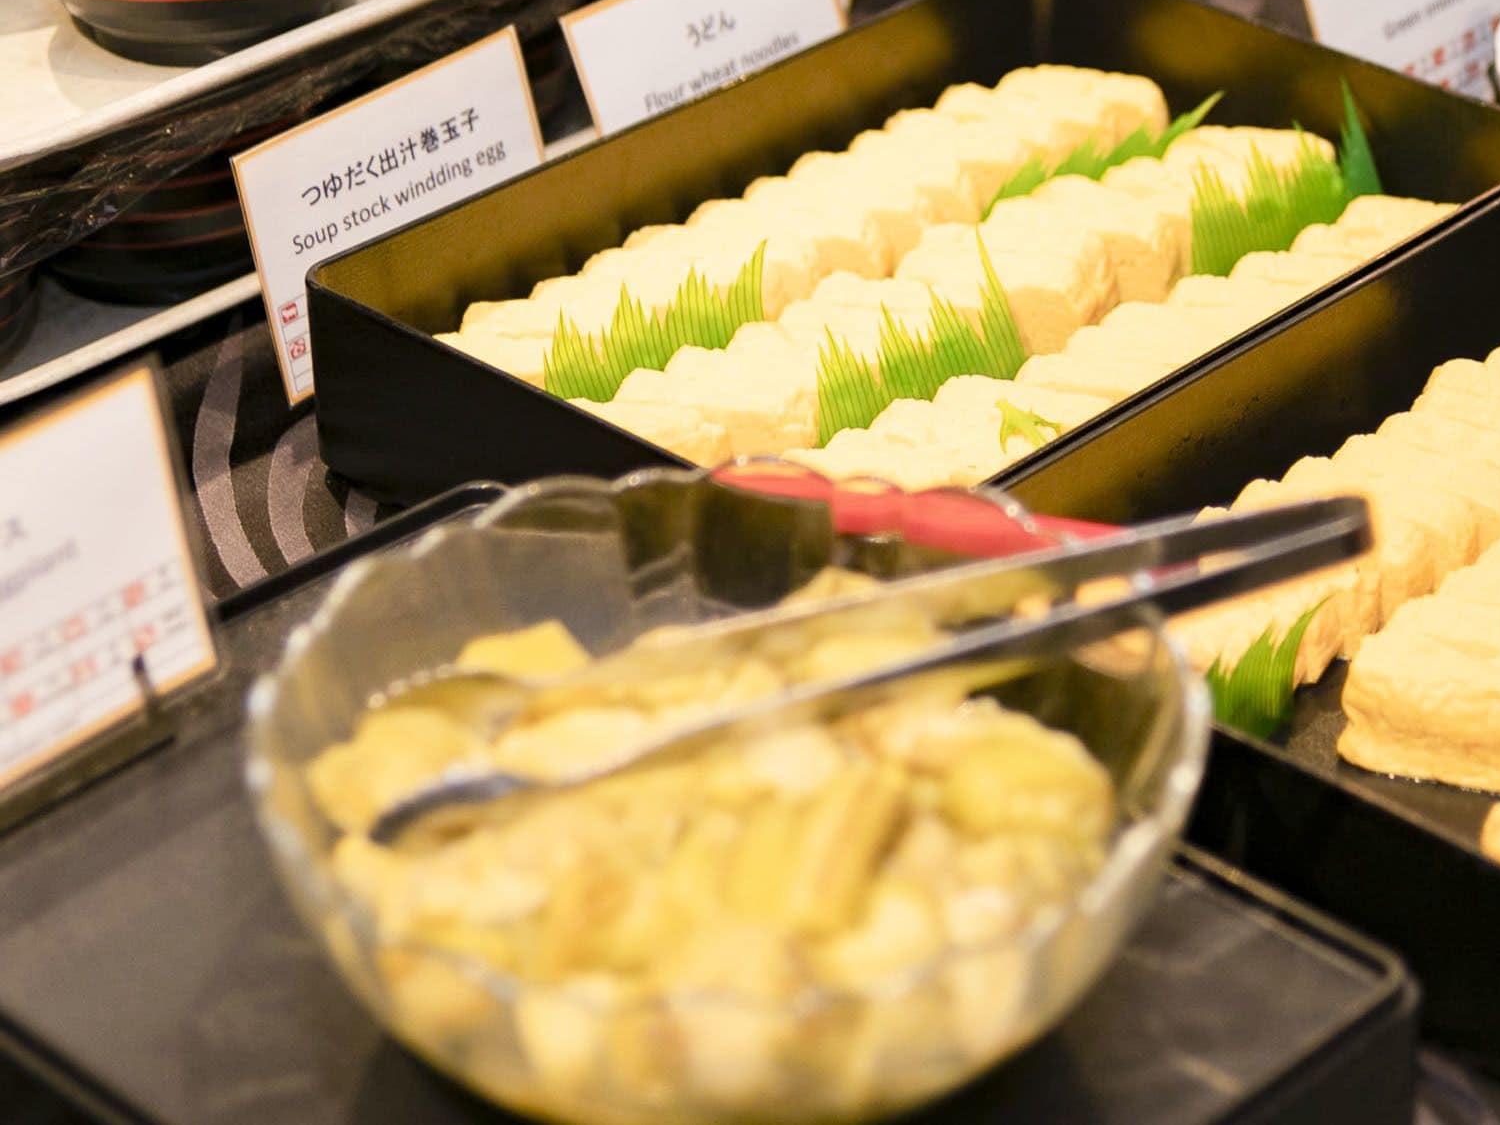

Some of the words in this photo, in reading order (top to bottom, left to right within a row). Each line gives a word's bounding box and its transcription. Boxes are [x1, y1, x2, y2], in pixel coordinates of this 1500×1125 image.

[644, 85, 685, 113] Flour
[688, 59, 738, 92] wheat
[740, 30, 800, 68] noodles
[687, 11, 736, 48] うどん
[292, 220, 339, 256] Soup
[342, 194, 392, 232] stock
[395, 155, 474, 207] windding
[476, 140, 507, 167] egg
[301, 107, 480, 207] つゆだく出汁巻玉子
